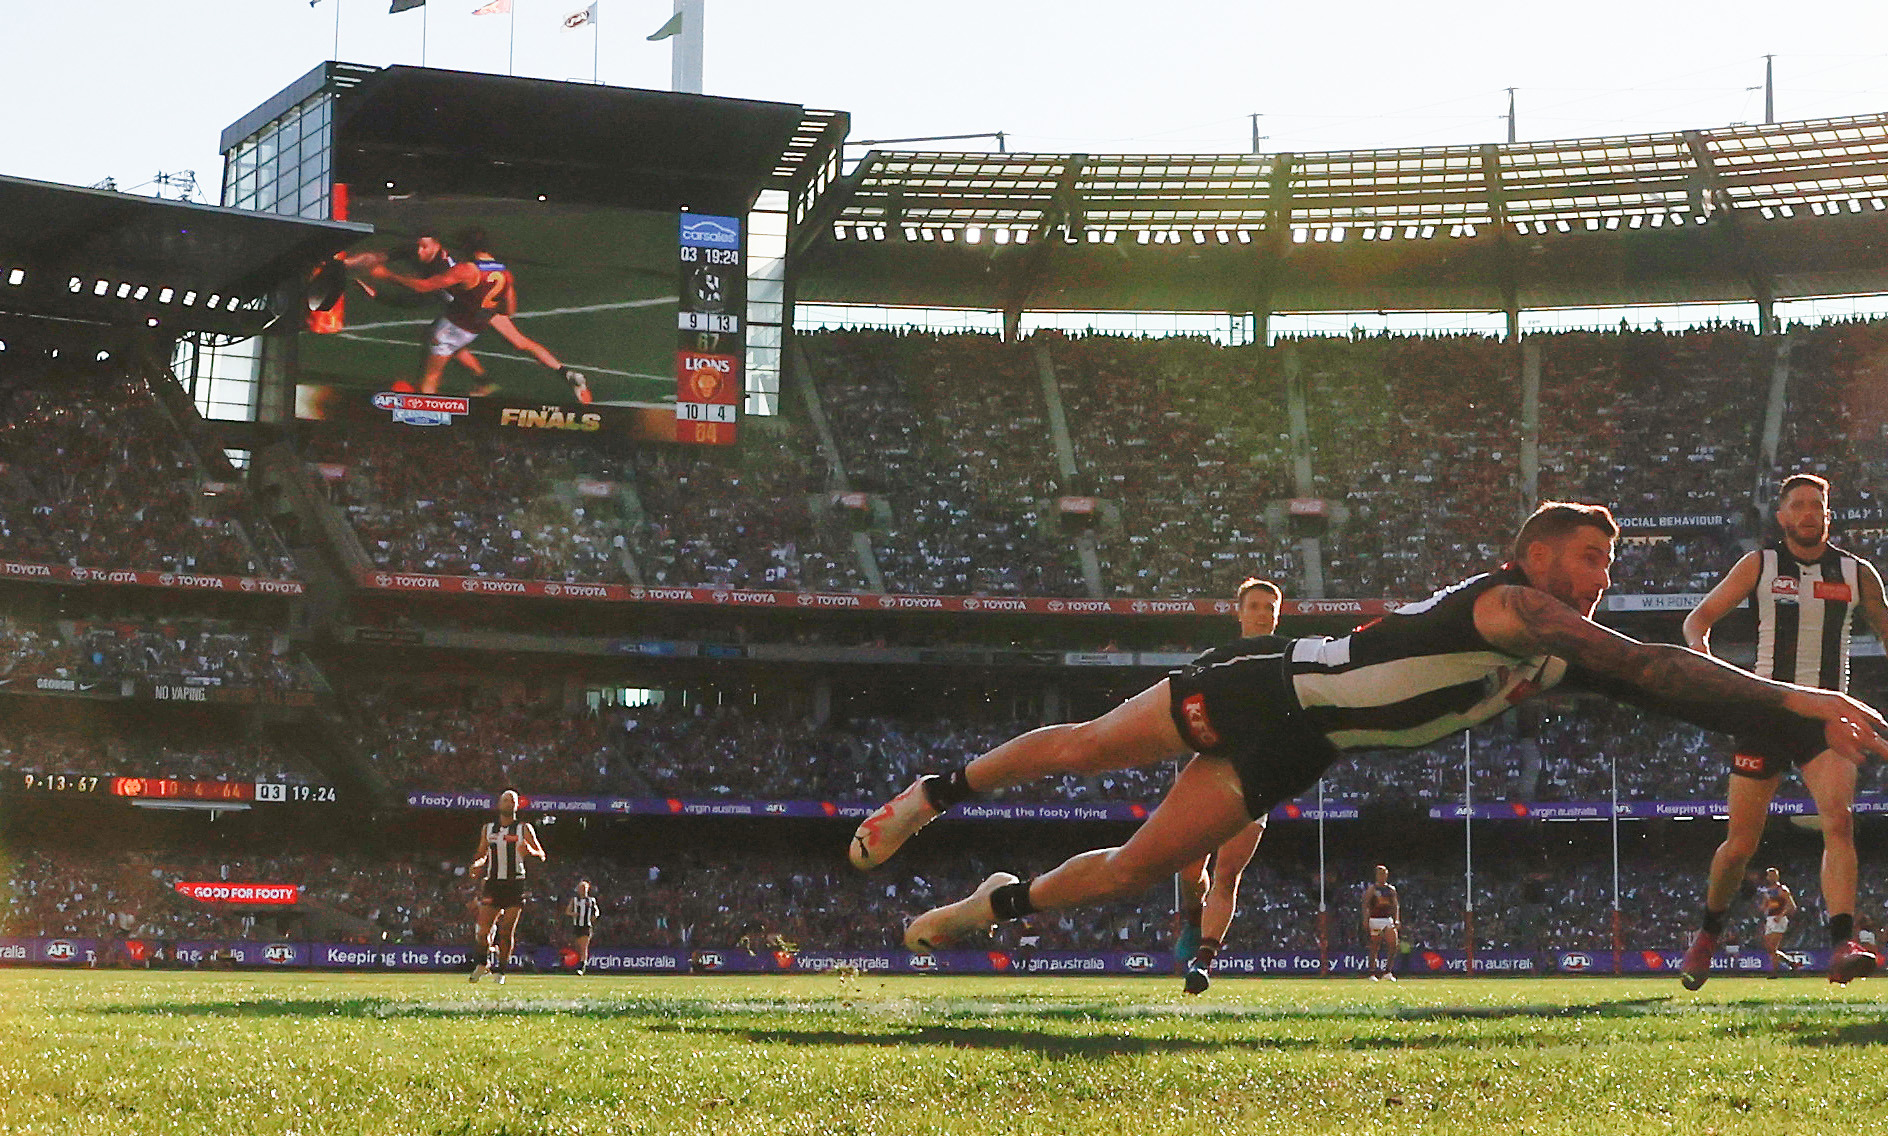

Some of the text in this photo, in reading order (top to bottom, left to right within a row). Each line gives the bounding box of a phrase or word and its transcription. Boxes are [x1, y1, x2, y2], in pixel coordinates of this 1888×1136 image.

[682, 229, 735, 243] carsales
[705, 249, 739, 264] 19:24
[481, 271, 506, 308] 2
[690, 314, 730, 331] 9 13
[685, 358, 730, 372] LIONS
[425, 401, 465, 410] TOYOTA
[685, 405, 725, 420] 10 4
[501, 408, 601, 432] FINALS
[1659, 516, 1723, 526] BEHAVIOUR
[178, 575, 223, 588] TOYOTA
[259, 582, 302, 594] TOYOTA
[396, 576, 1362, 613] TOYOTA TOYOTA TOYOTA TOYOTA TOYOTA TOYOTA TOYOTA TOYOTA TOYOTA TOYOTA TOYOTA
[155, 686, 206, 701] NO VAPING
[292, 786, 337, 802] 19:24
[420, 796, 453, 808] footy
[457, 796, 490, 809] flying
[1770, 802, 1804, 814] flying
[1016, 808, 1034, 816] the
[1040, 808, 1070, 819] footy
[1075, 808, 1107, 819] flying
[194, 886, 294, 900] GOOD FOR FOOTY
[48, 944, 75, 956] AFL
[265, 946, 294, 958] AFL
[402, 950, 426, 964] the
[622, 952, 676, 967] australia
[797, 956, 832, 970] virgin
[910, 956, 936, 966] AFL
[1050, 958, 1104, 970] australia
[1125, 956, 1152, 966] AFL
[1260, 956, 1286, 968] the
[1294, 956, 1338, 970] fooy
[1563, 956, 1590, 966] AFL
